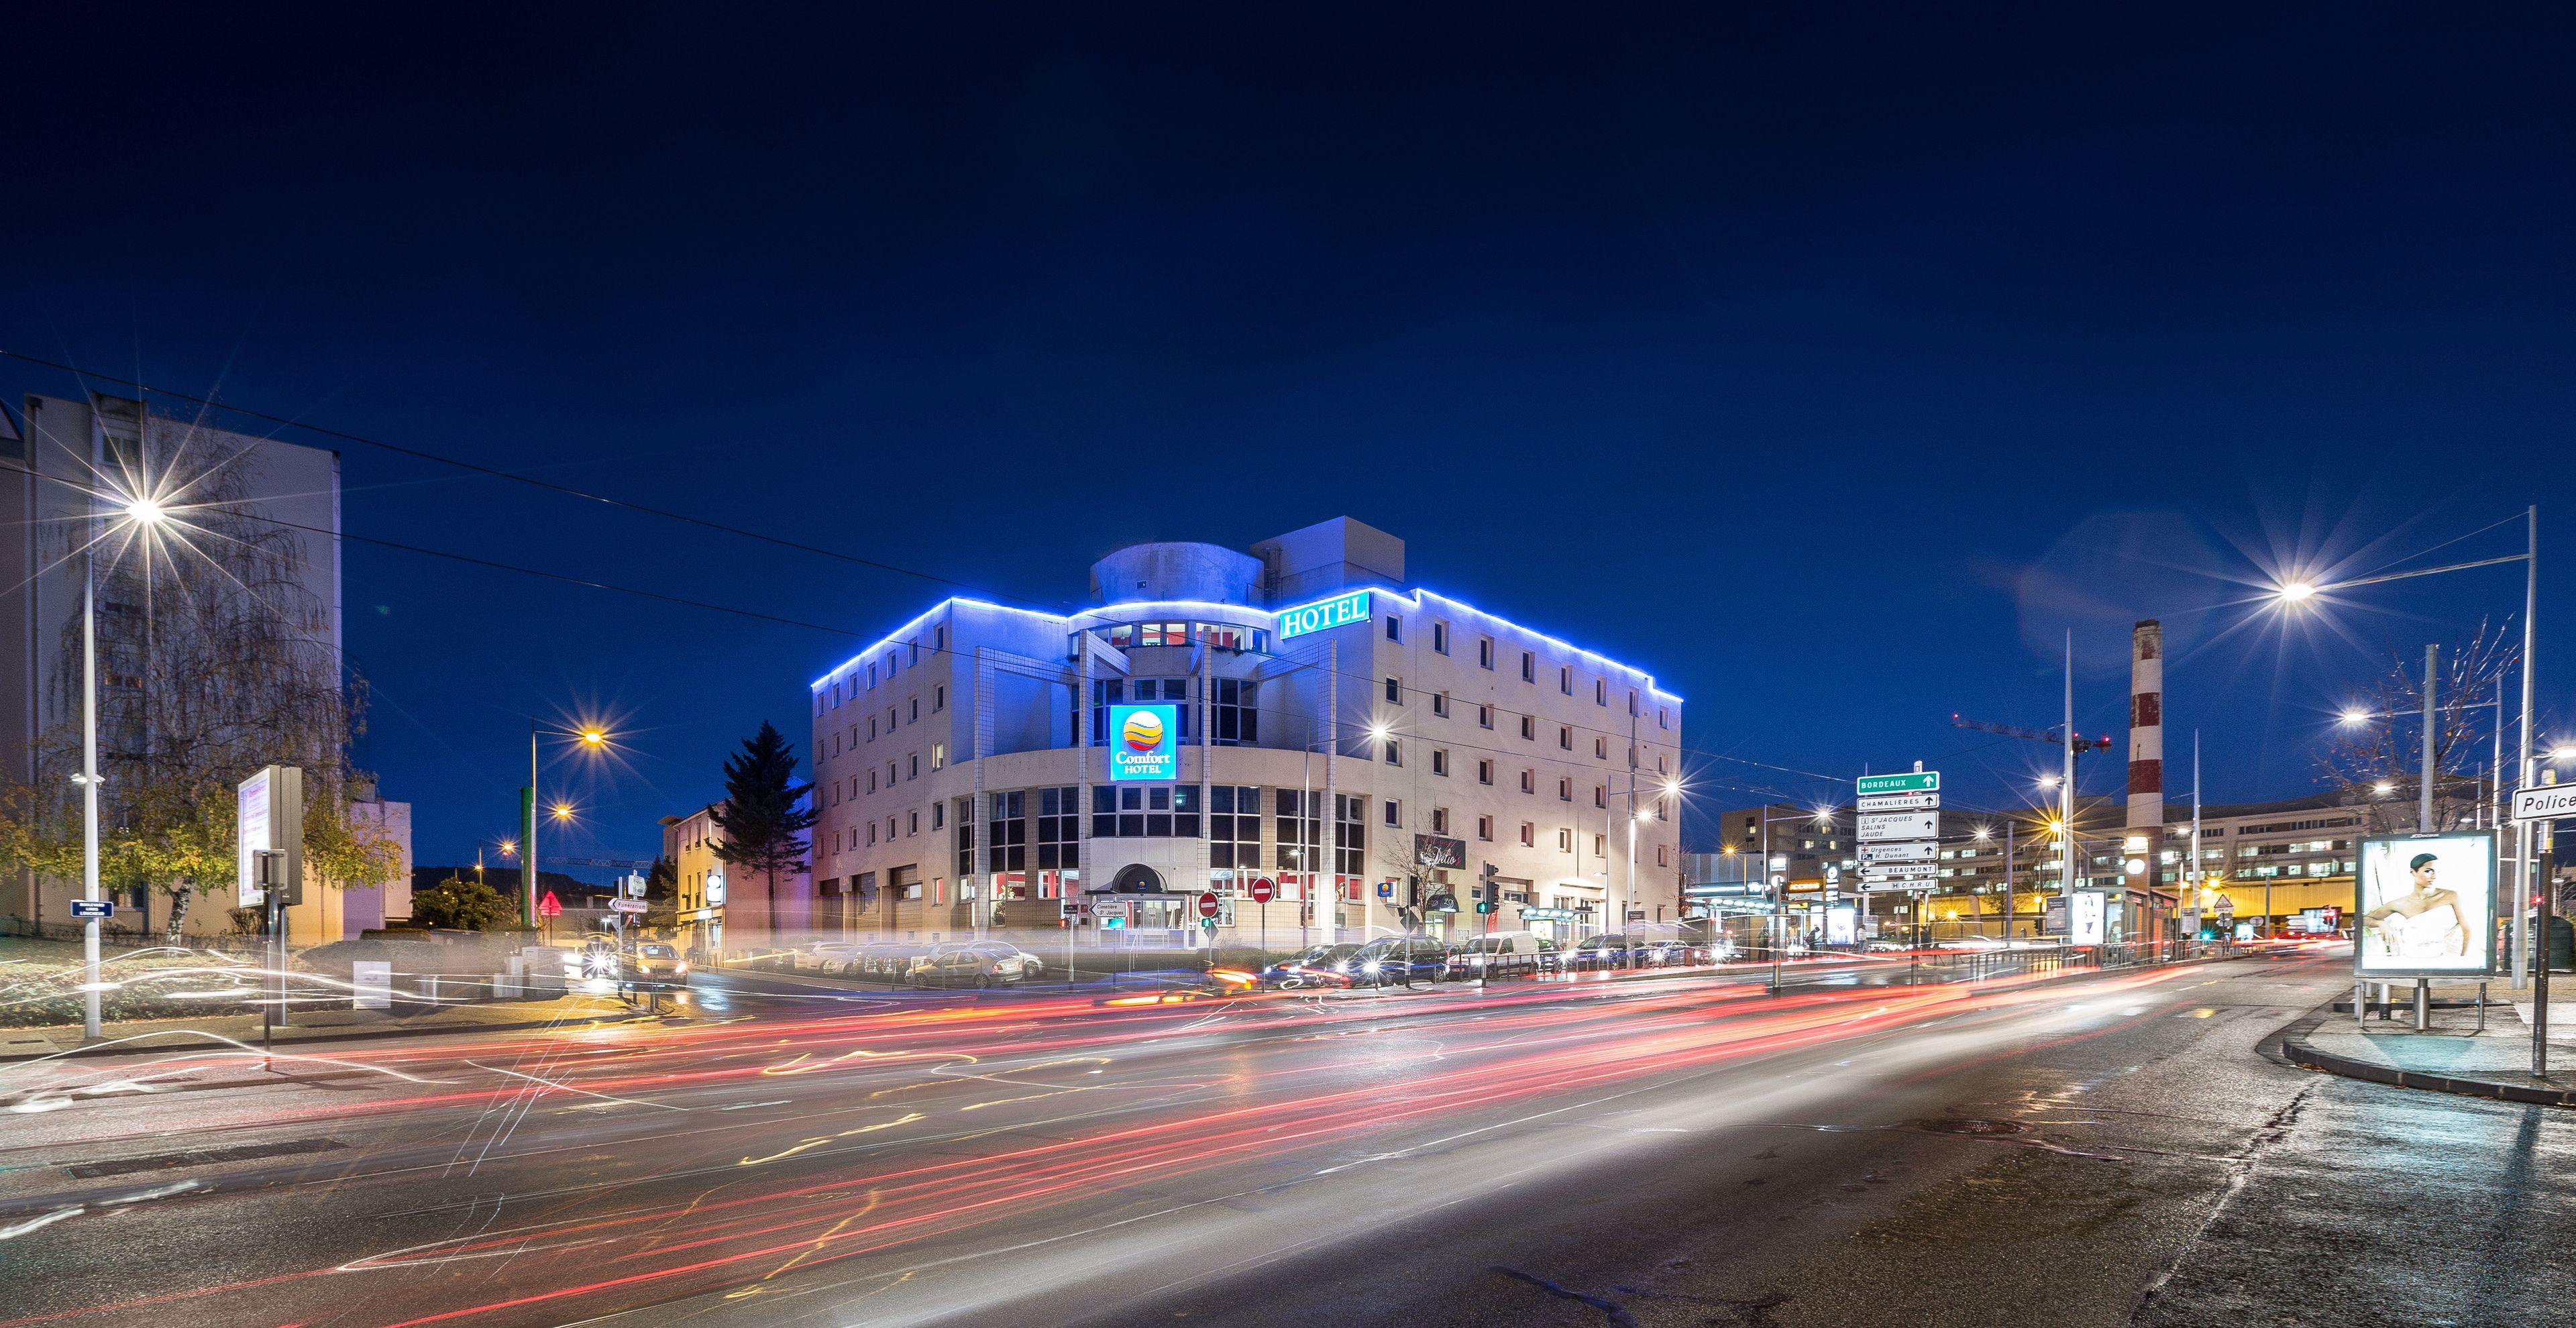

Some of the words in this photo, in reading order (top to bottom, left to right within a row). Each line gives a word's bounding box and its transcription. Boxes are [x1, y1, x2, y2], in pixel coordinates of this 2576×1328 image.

[1283, 596, 1366, 636] HOTEL
[1115, 751, 1171, 764] Comfort
[1124, 765, 1162, 774] HOTEL
[1861, 779, 1907, 789] BORDEAUX
[2522, 795, 2576, 812] Police
[618, 901, 646, 909] Funérarium
